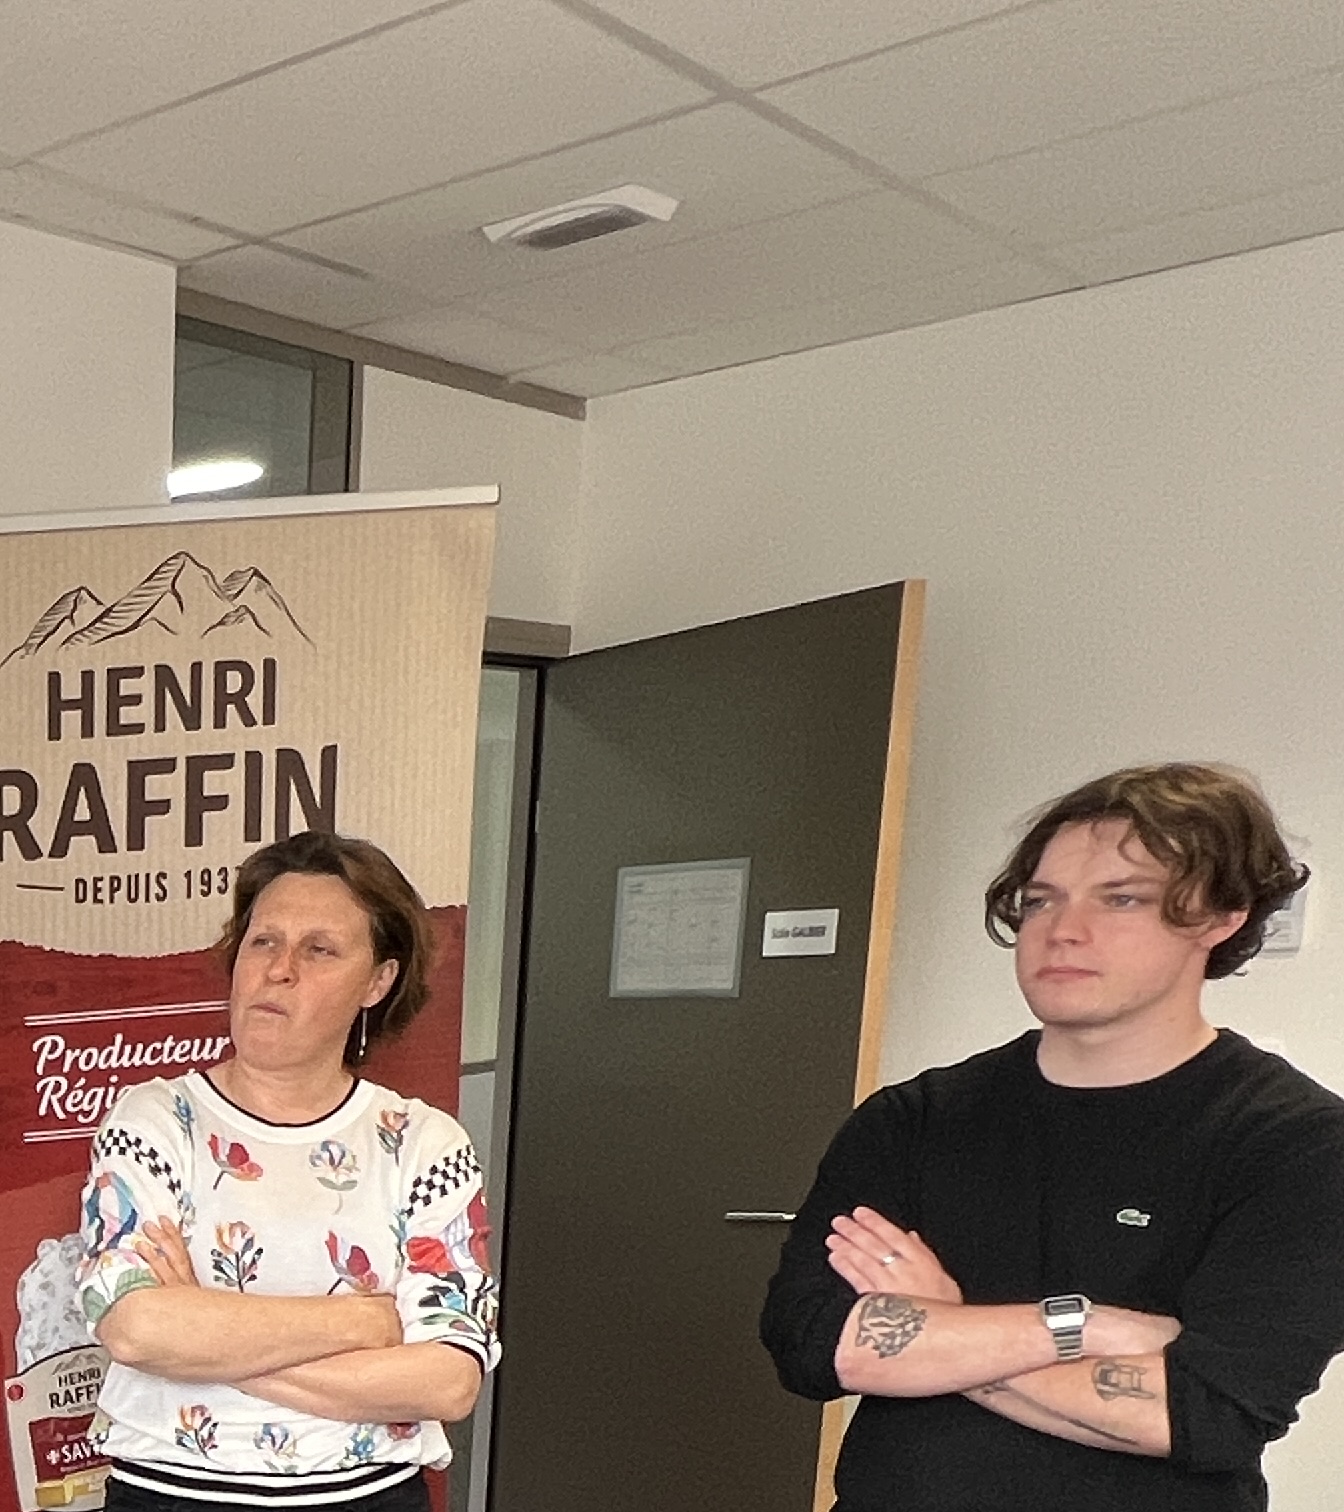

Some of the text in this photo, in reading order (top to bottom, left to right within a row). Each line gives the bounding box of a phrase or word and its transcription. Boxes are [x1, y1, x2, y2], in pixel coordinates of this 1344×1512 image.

[47, 657, 277, 741] HENRI
[74, 866, 241, 904] DEPUIS 193
[32, 1033, 231, 1076] Producteur
[36, 1075, 126, 1124] Régi
[48, 1382, 103, 1409] RAFFI
